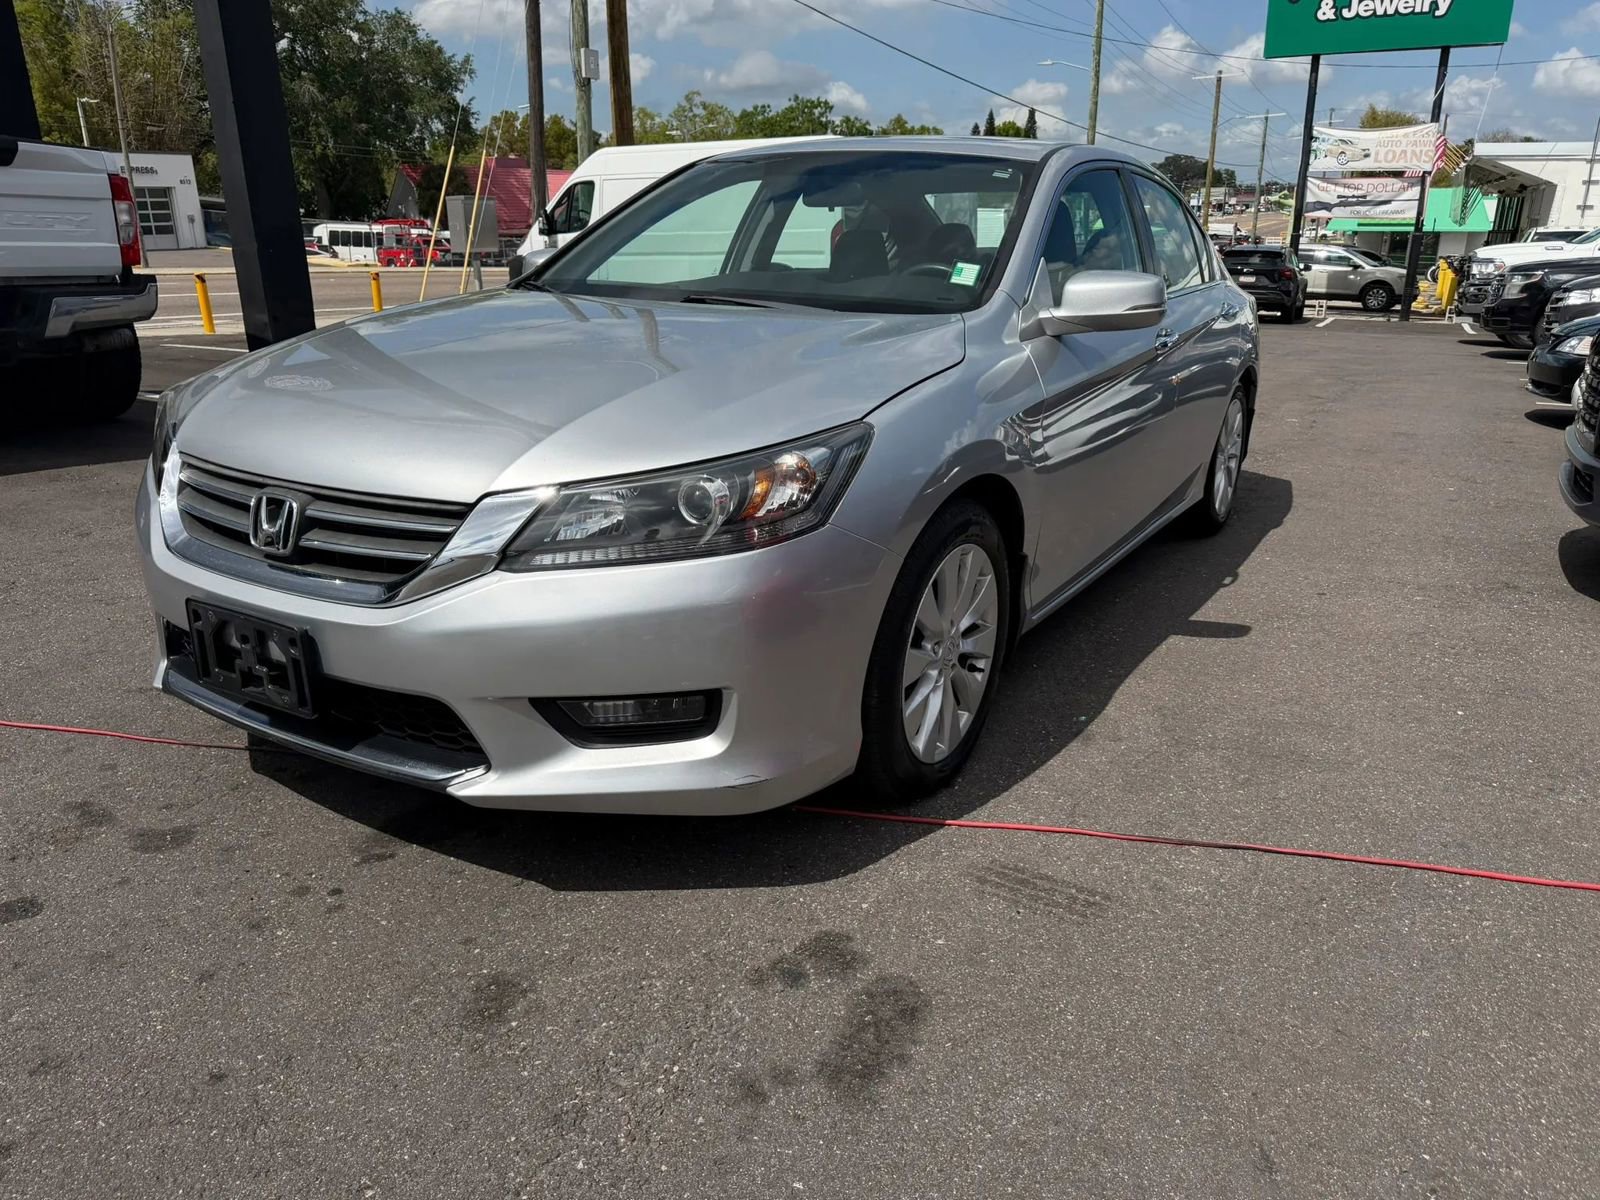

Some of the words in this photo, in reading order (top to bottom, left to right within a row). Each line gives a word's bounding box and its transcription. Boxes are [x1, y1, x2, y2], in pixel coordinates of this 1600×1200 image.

[1316, 0, 1336, 21] &
[1342, 0, 1451, 17] Jewelry
[1375, 140, 1403, 148] AUTO
[1405, 139, 1435, 148] PAWN
[1373, 149, 1434, 164] LOANS
[120, 166, 156, 174] EPRESS
[1317, 182, 1339, 192] GET
[1342, 183, 1364, 193] TOP
[1366, 182, 1414, 193] DOLLAR
